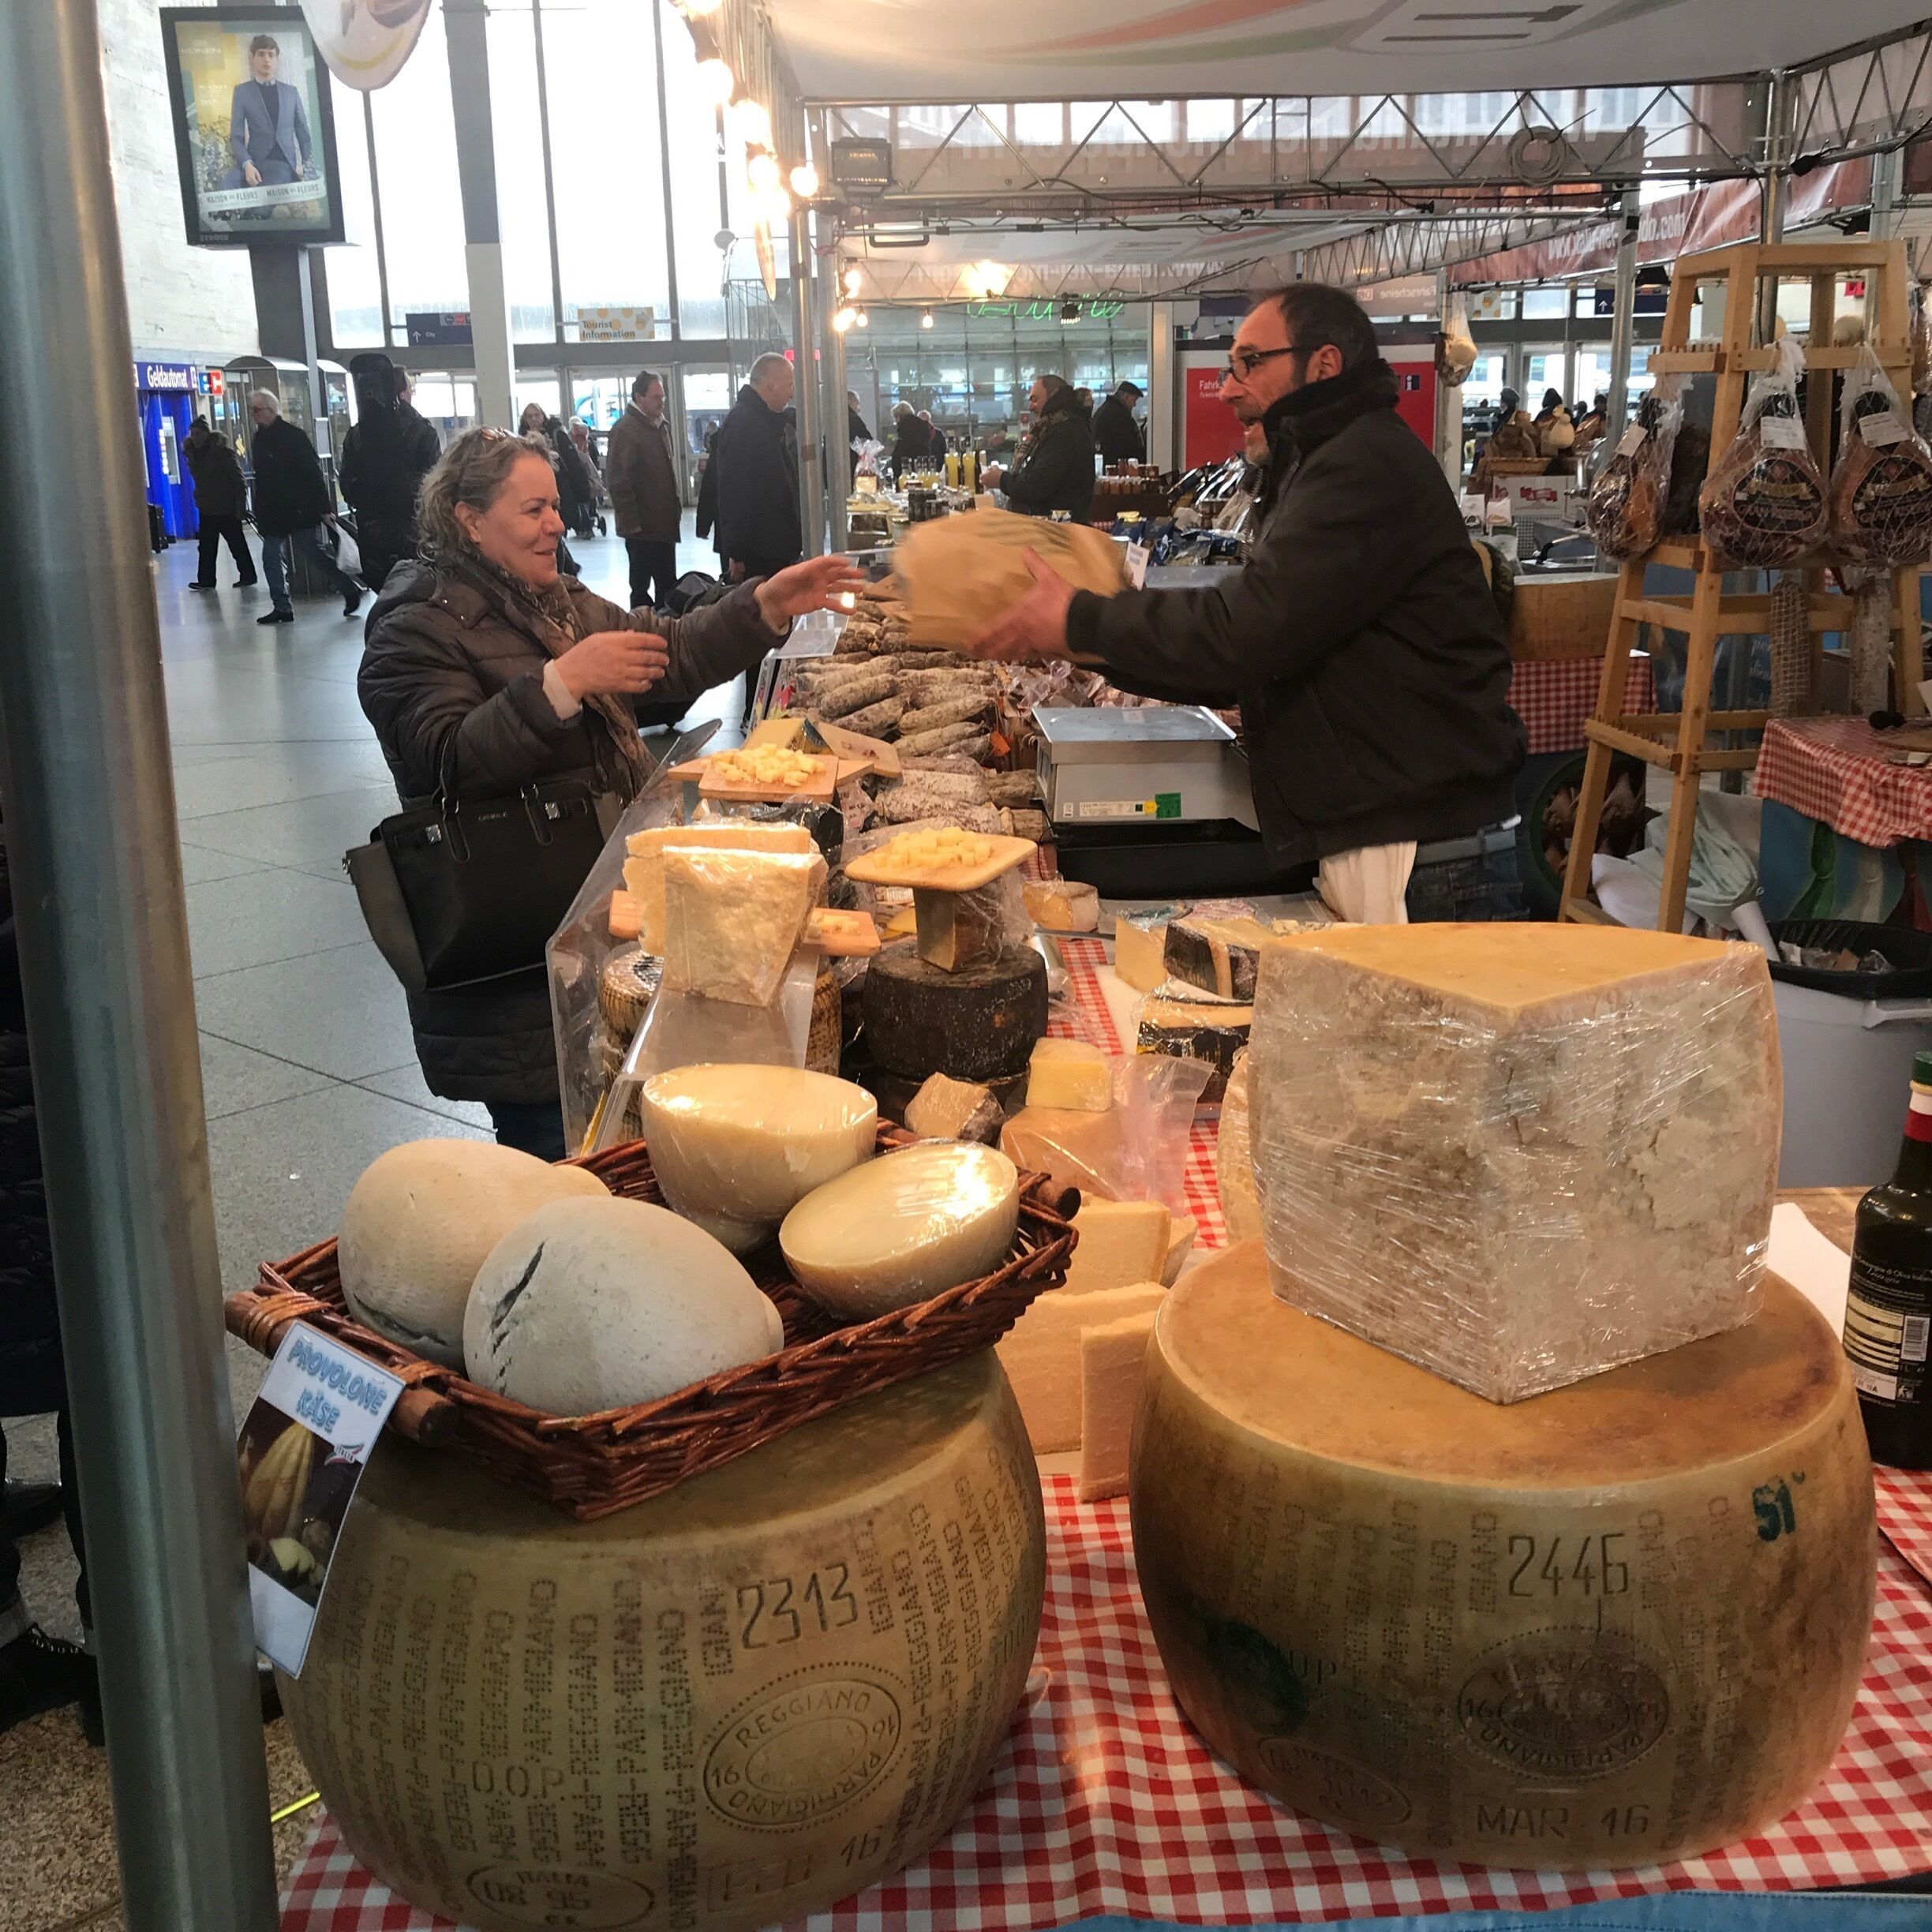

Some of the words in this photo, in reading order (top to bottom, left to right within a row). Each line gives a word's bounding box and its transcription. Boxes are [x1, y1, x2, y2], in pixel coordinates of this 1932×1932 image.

[206, 193, 228, 204] MAISON
[237, 191, 258, 200] FLEURS
[267, 188, 289, 197] MAISON
[298, 183, 319, 194] FLEURS
[582, 320, 612, 329] Tourist
[582, 328, 635, 339] Information
[148, 365, 189, 388] Geldautomat
[287, 1339, 388, 1416] PROVOLONE
[296, 1387, 340, 1434] KÄSE
[1508, 1533, 1629, 1598] 2446
[737, 1562, 859, 1651] 2313
[736, 1689, 871, 1750] REGGIANO
[711, 1764, 741, 1789] 16
[1476, 1803, 1570, 1840] MAR
[1601, 1803, 1651, 1840] 16
